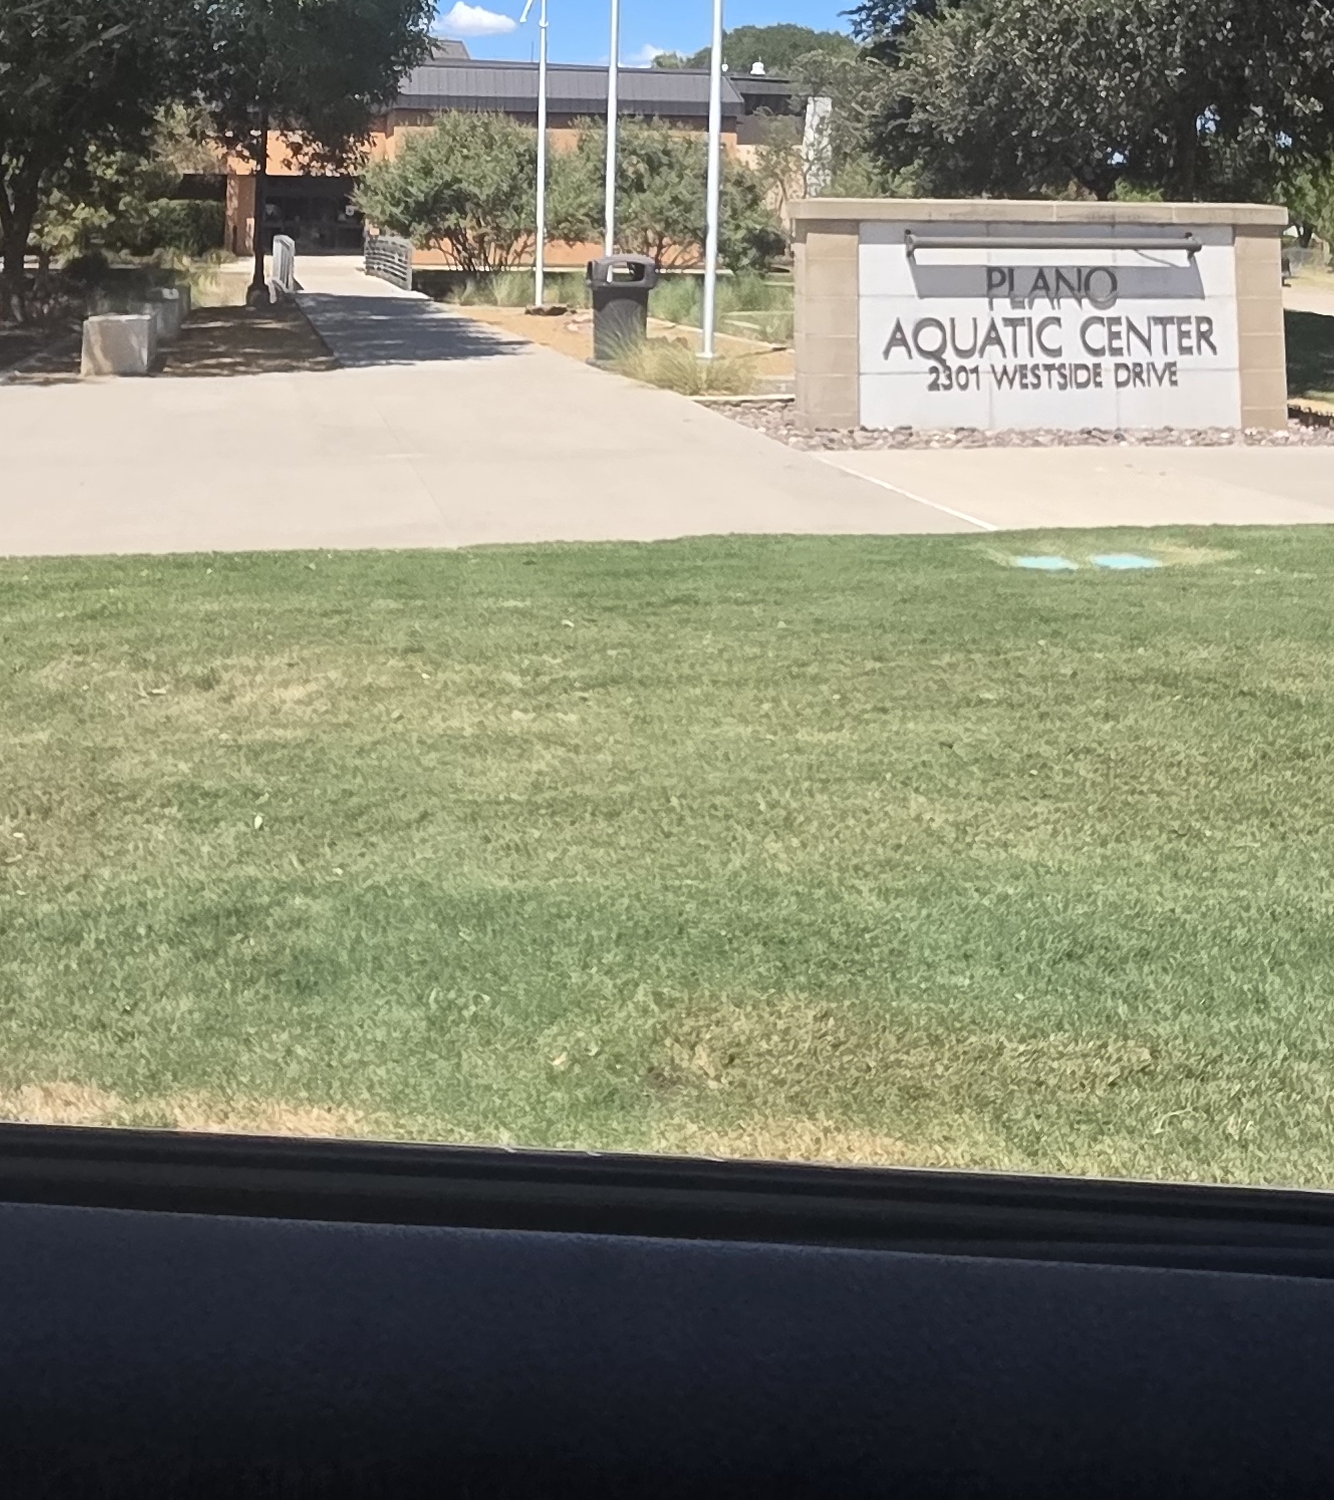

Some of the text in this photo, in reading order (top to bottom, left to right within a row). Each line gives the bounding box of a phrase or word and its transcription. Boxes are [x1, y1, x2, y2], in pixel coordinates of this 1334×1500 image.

[985, 266, 1118, 311] PLANO
[882, 315, 1218, 367] AQUATIC CENTER
[927, 361, 1178, 391] 2301 WESTSIDE DRIVE
